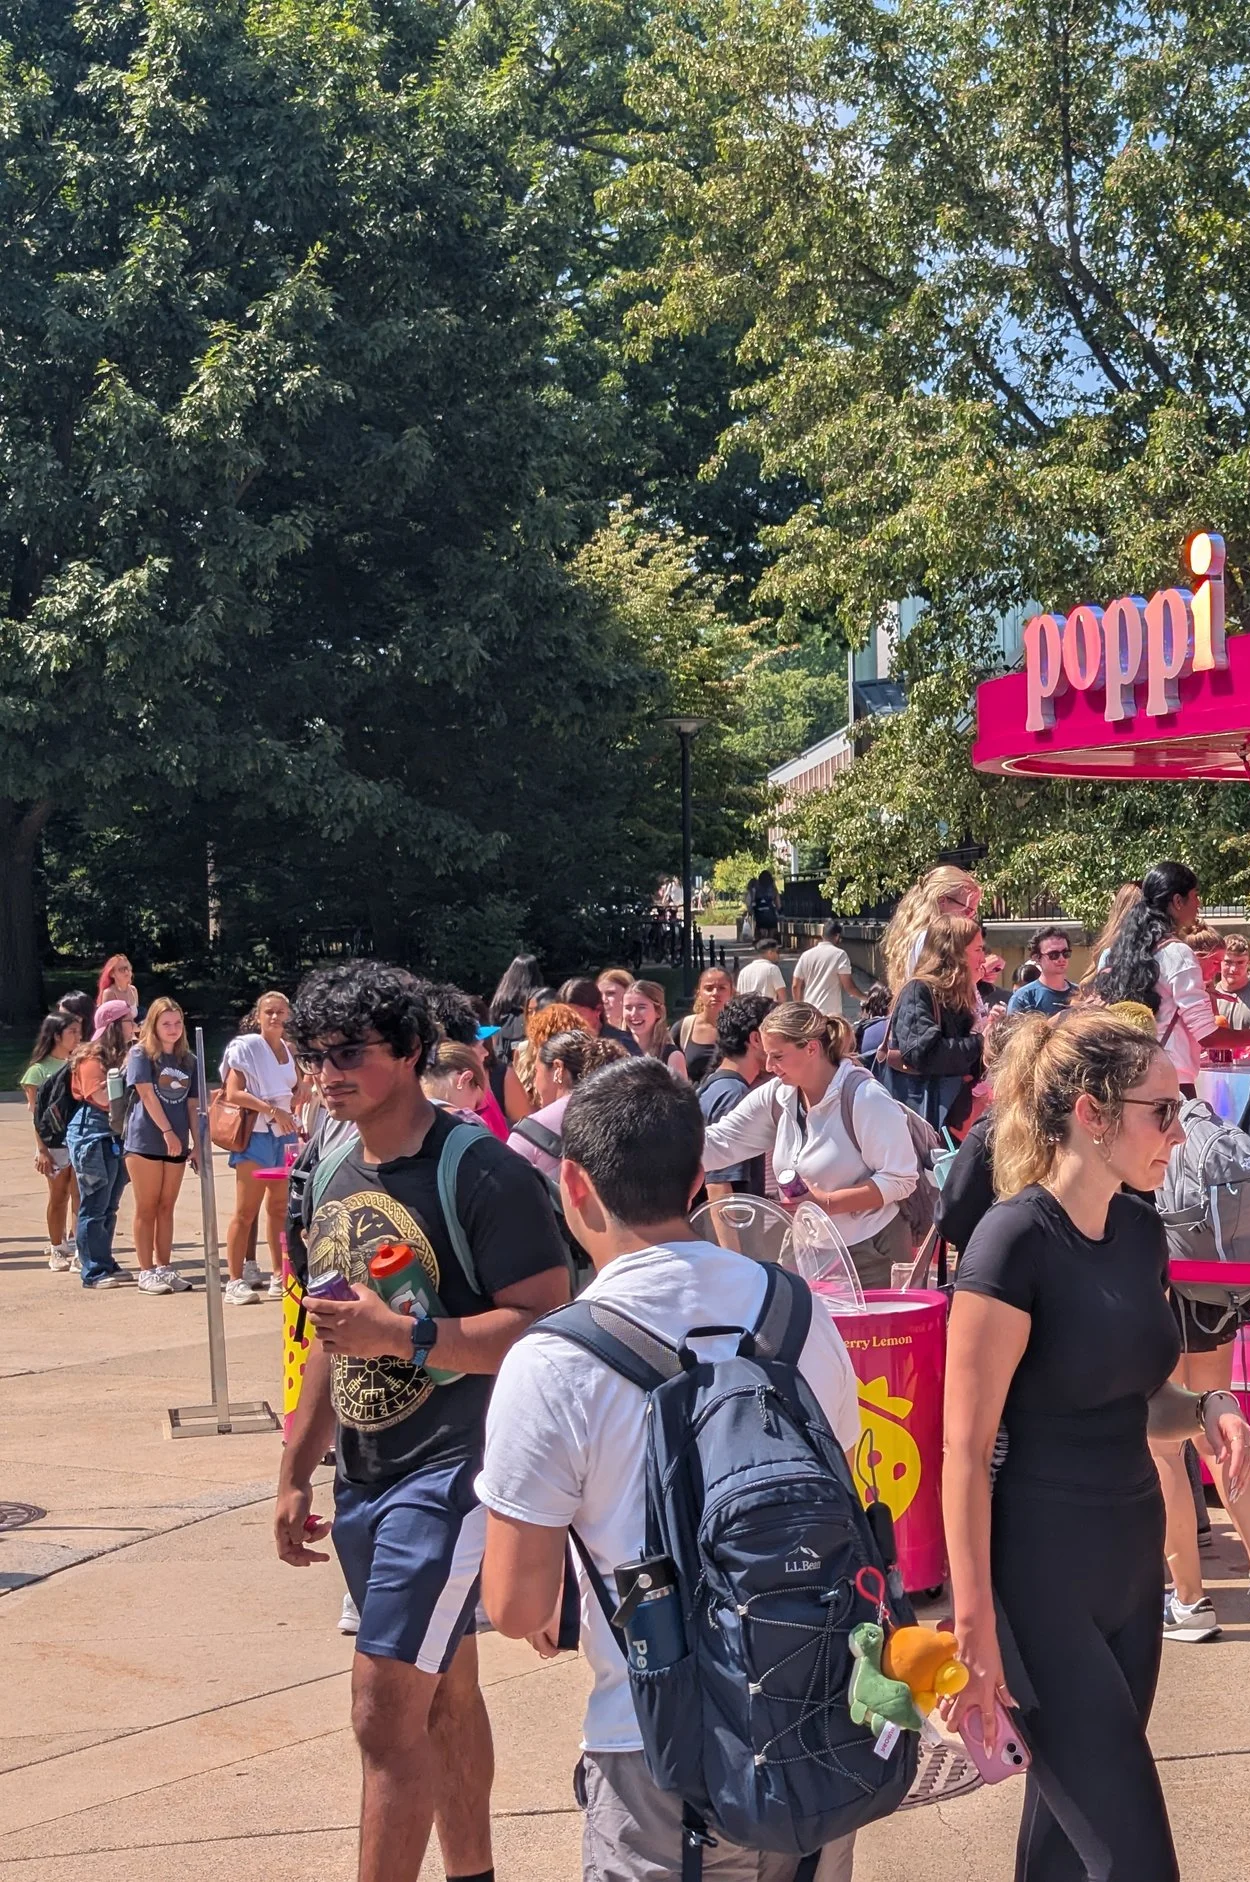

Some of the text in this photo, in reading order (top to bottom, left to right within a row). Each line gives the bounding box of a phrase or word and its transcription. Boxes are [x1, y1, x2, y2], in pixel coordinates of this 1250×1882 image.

[1024, 532, 1224, 732] poppi
[845, 1335, 913, 1351] erry Lemon
[632, 1639, 648, 1669] Pe
